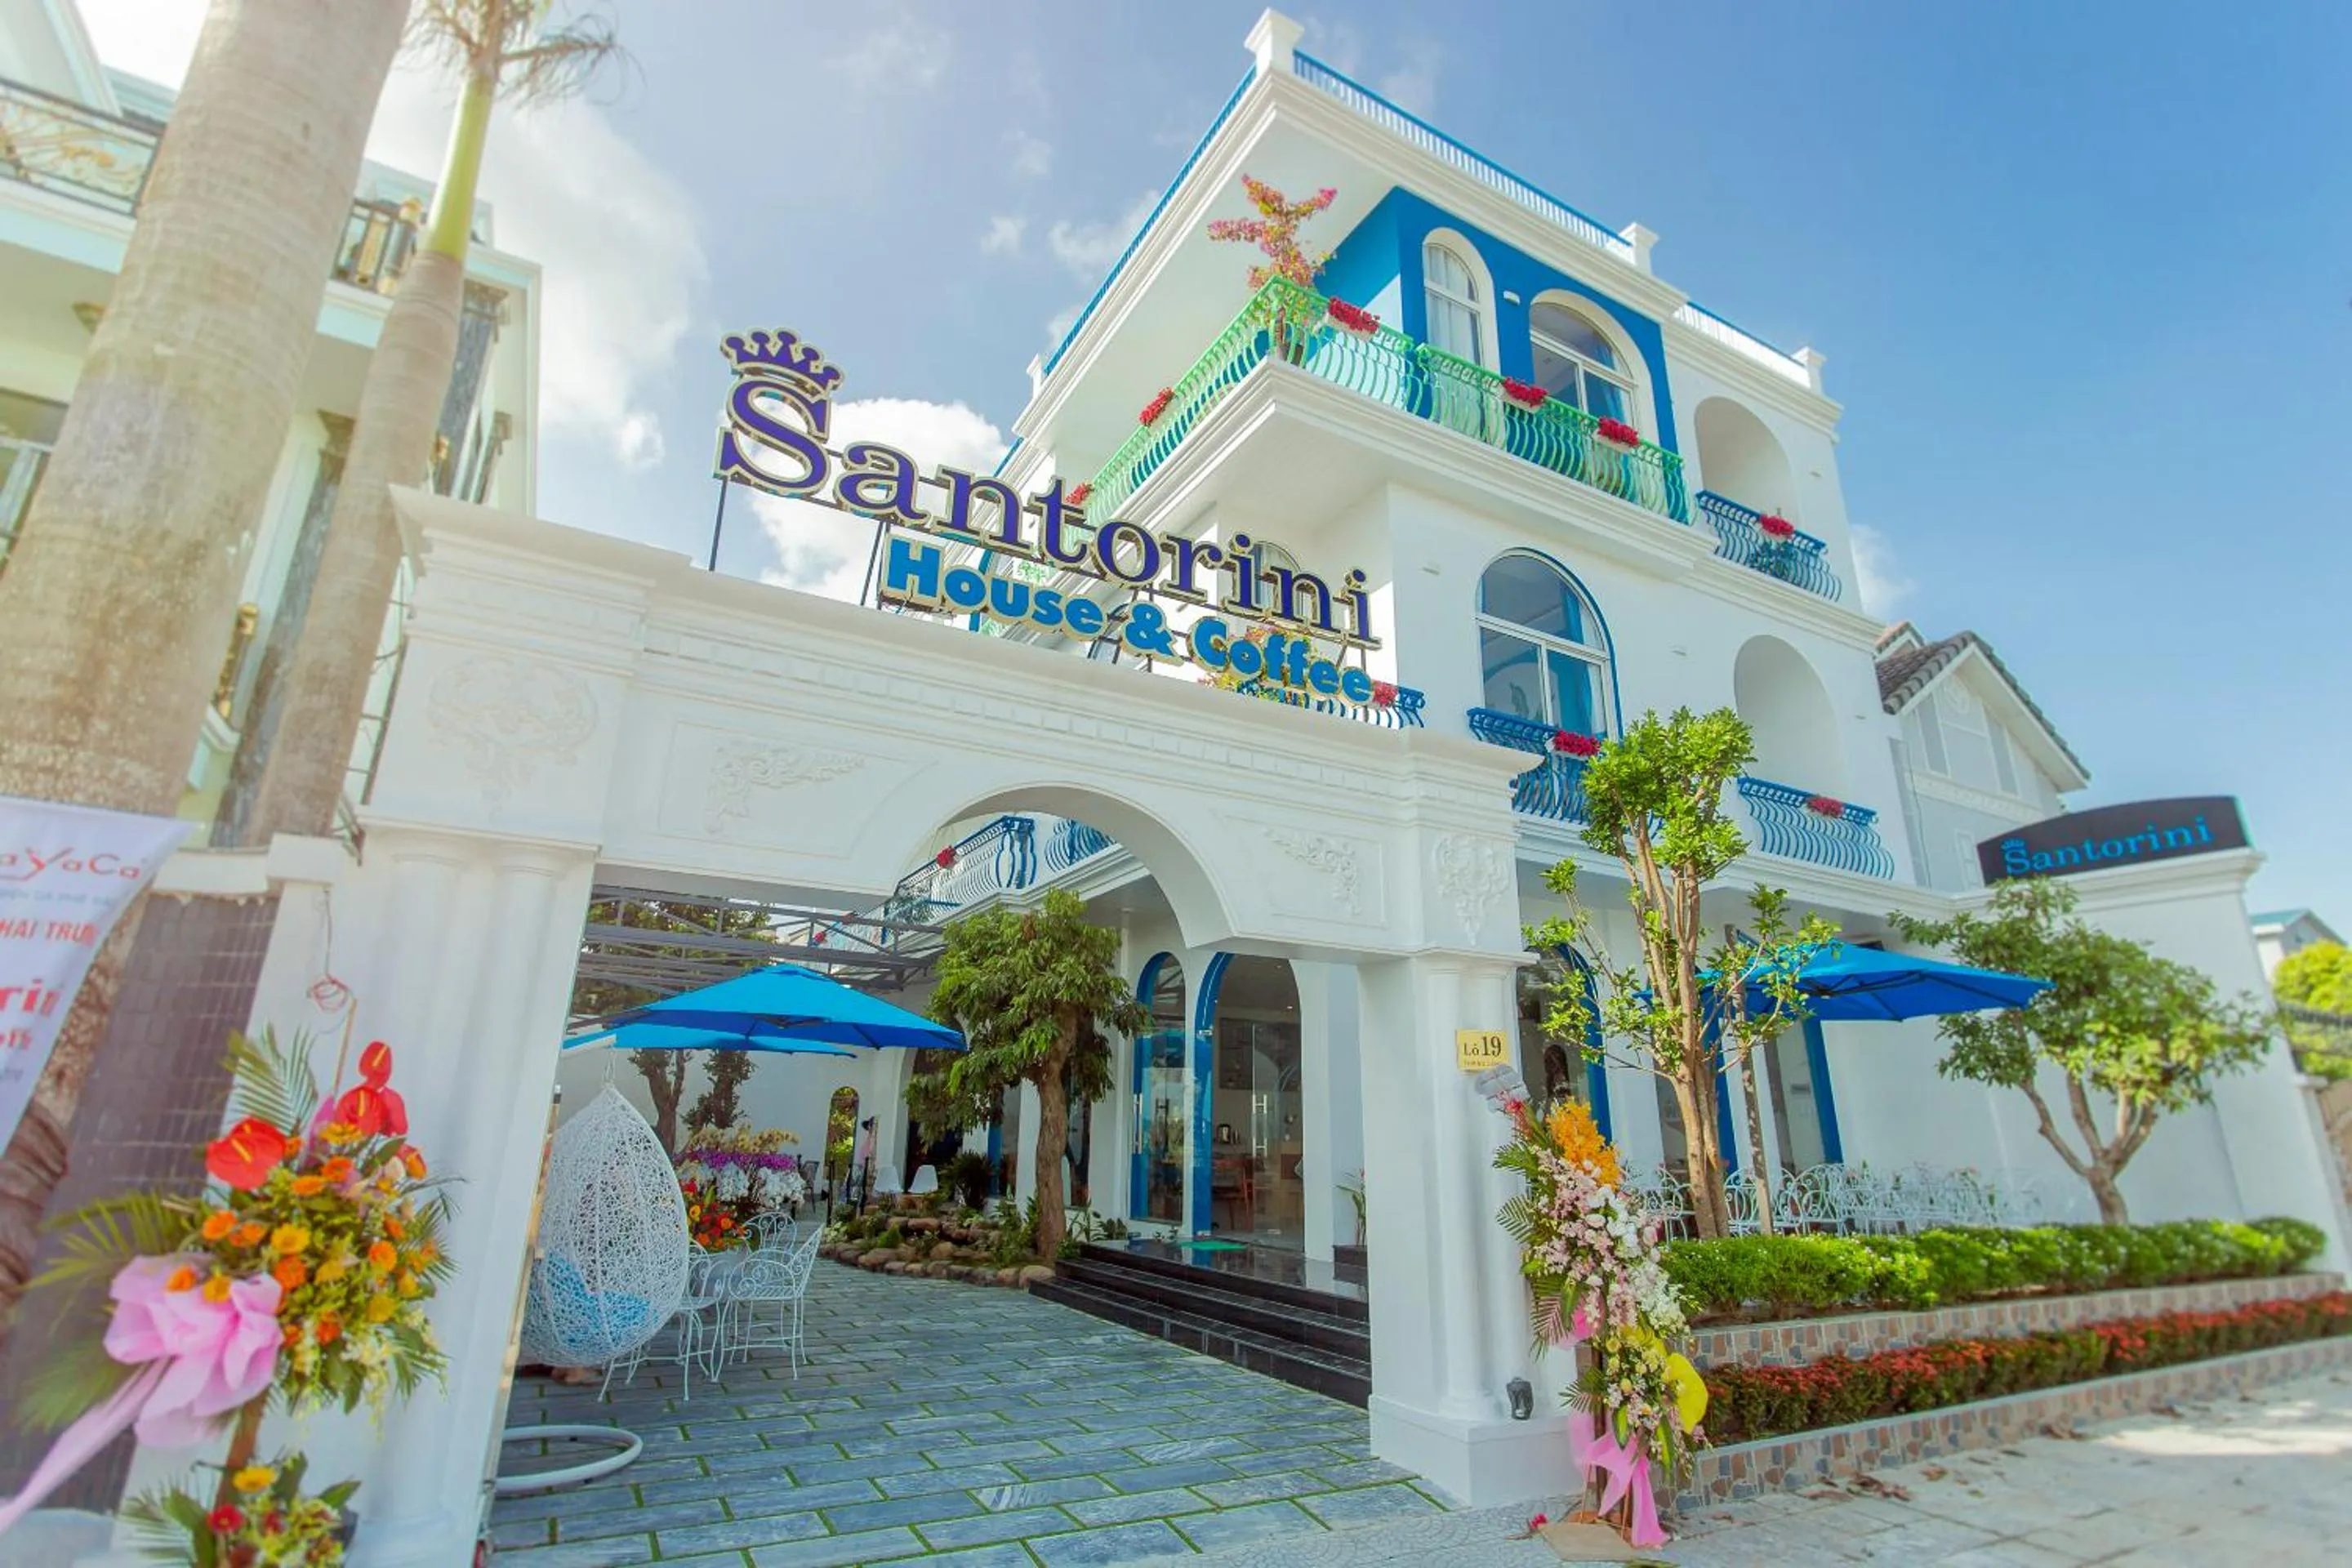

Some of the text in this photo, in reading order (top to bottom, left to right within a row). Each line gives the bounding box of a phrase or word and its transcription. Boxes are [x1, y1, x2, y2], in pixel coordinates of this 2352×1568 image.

[713, 372, 1382, 650] Santorini
[880, 533, 1376, 707] House & Coffee
[2002, 814, 2216, 875] Santorini
[1481, 1036, 1502, 1057] 19
